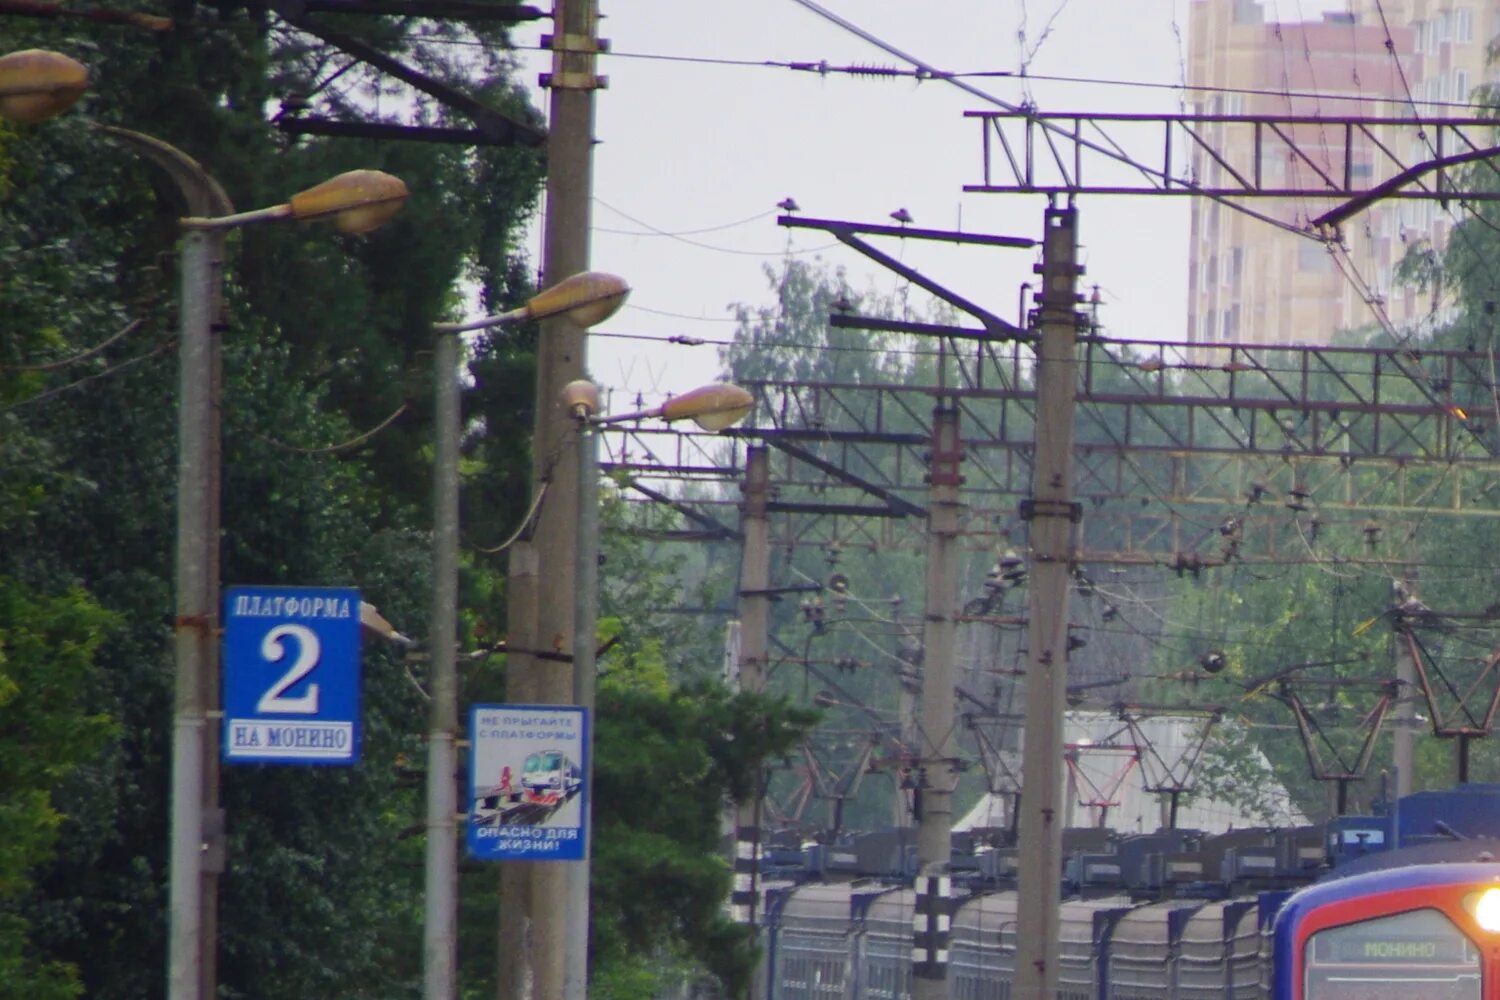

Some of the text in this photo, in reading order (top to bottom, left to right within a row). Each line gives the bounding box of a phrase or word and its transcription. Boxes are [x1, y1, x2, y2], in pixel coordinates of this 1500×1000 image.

[235, 595, 351, 618] ПЛАТФОРМА
[257, 623, 321, 714] 2
[481, 716, 573, 727] НЕ ПРЫГАЙТЕ
[234, 726, 348, 749] НА МОНИНО
[491, 729, 577, 741] ПЛАТФОРМЫ
[476, 826, 578, 841] ОПАСНО ДЛЯ
[498, 838, 560, 852] ЖИЗНИ!
[1365, 942, 1436, 958] МОНИНО
